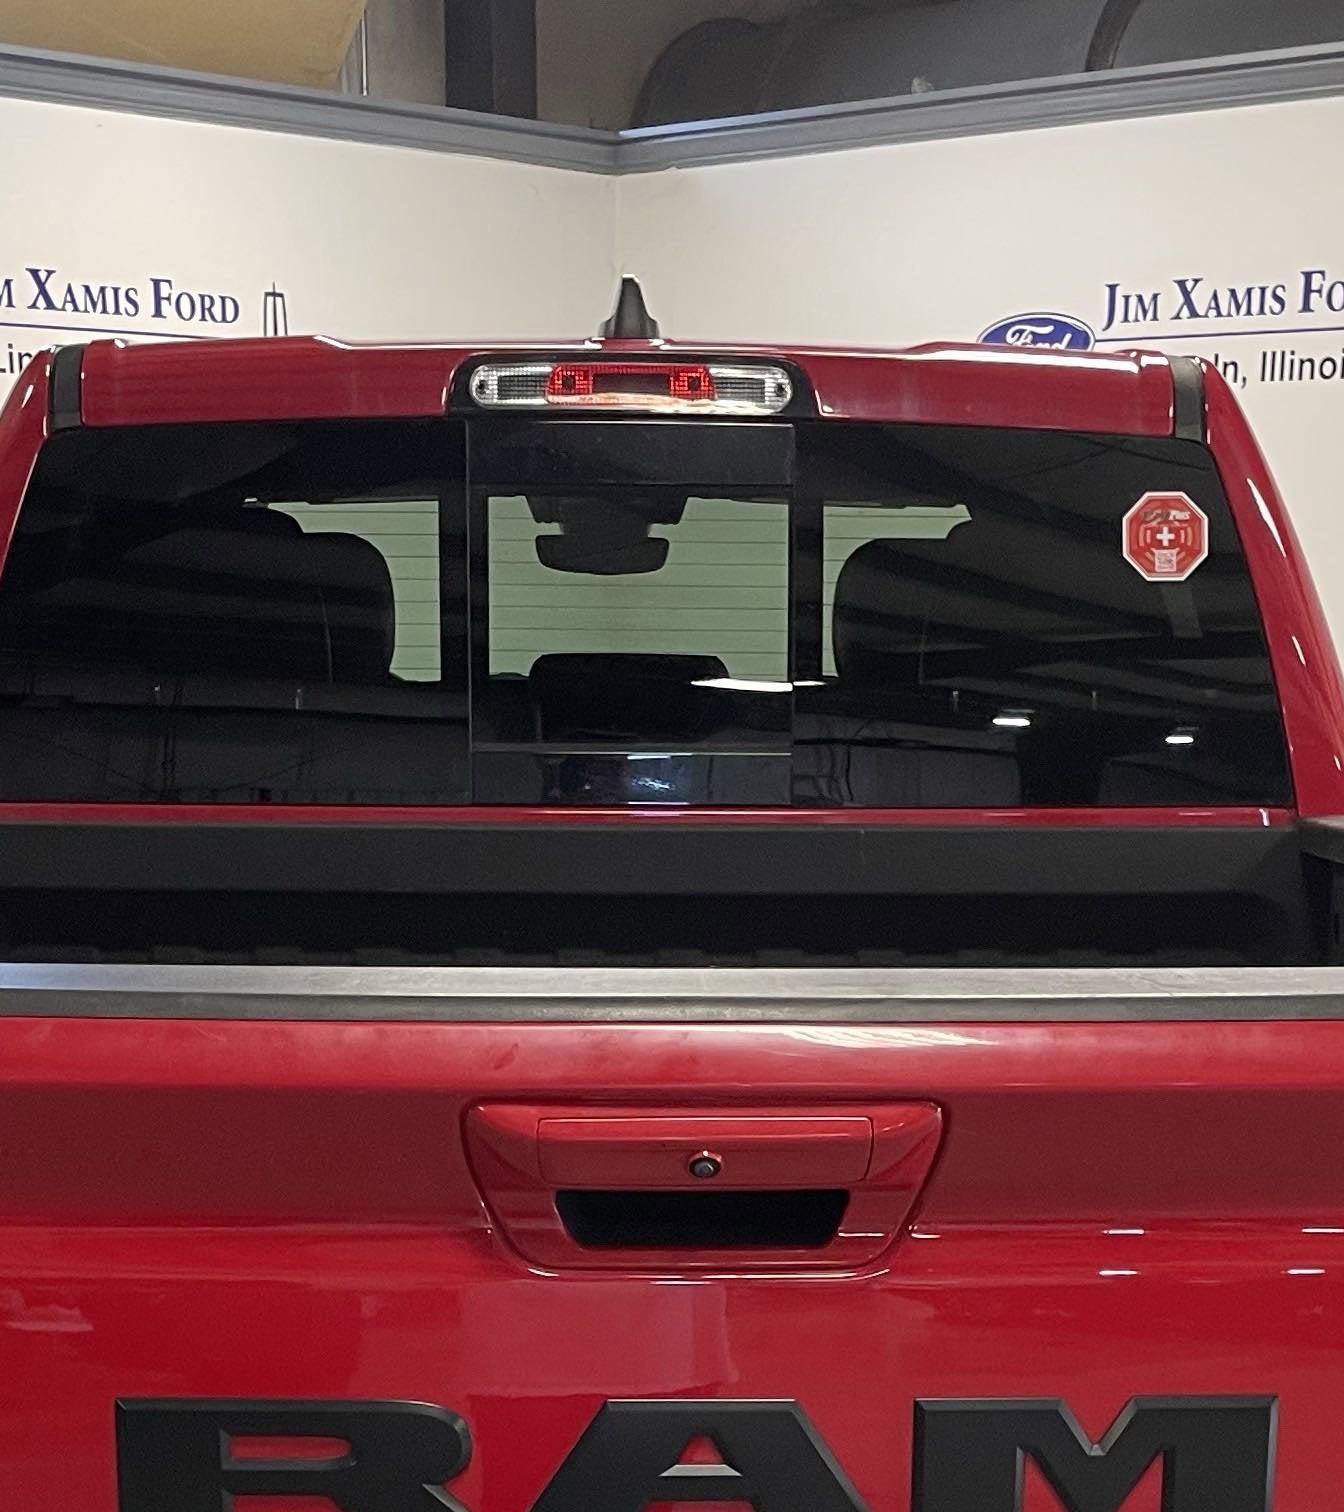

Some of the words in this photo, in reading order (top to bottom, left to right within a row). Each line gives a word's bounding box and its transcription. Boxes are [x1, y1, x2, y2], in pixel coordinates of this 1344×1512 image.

[25, 268, 141, 317] XAMIS
[150, 278, 241, 324] FORD
[1102, 283, 1160, 331] JIM
[1171, 278, 1286, 320] XAMIS
